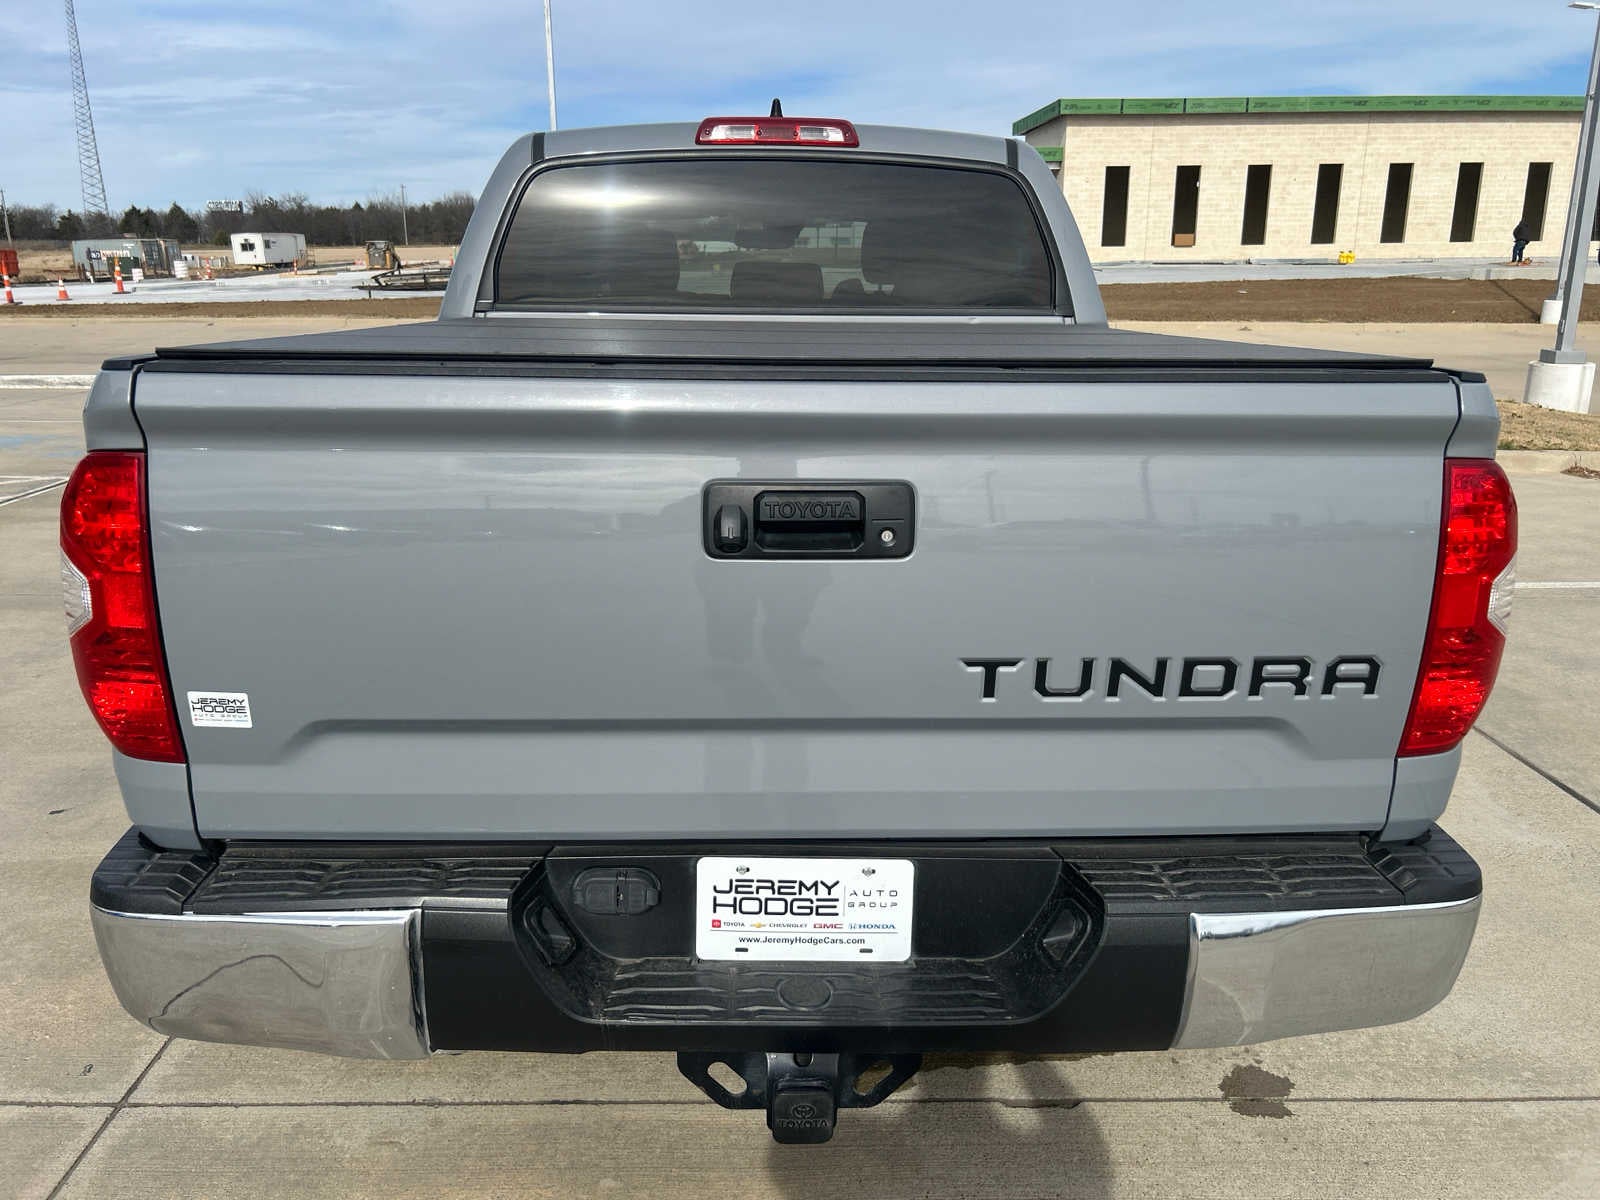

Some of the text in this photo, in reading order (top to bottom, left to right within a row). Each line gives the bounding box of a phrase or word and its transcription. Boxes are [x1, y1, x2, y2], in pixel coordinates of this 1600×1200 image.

[764, 501, 857, 519] TOYOTA
[959, 656, 1383, 702] TUNDRA
[191, 697, 245, 705] JEREMY
[192, 704, 247, 713] HODGE
[713, 878, 840, 896] JEREMY
[849, 889, 898, 897] AUTO
[712, 896, 840, 917] HODGE
[738, 935, 866, 946] www.JeremyHodgeCars.com
